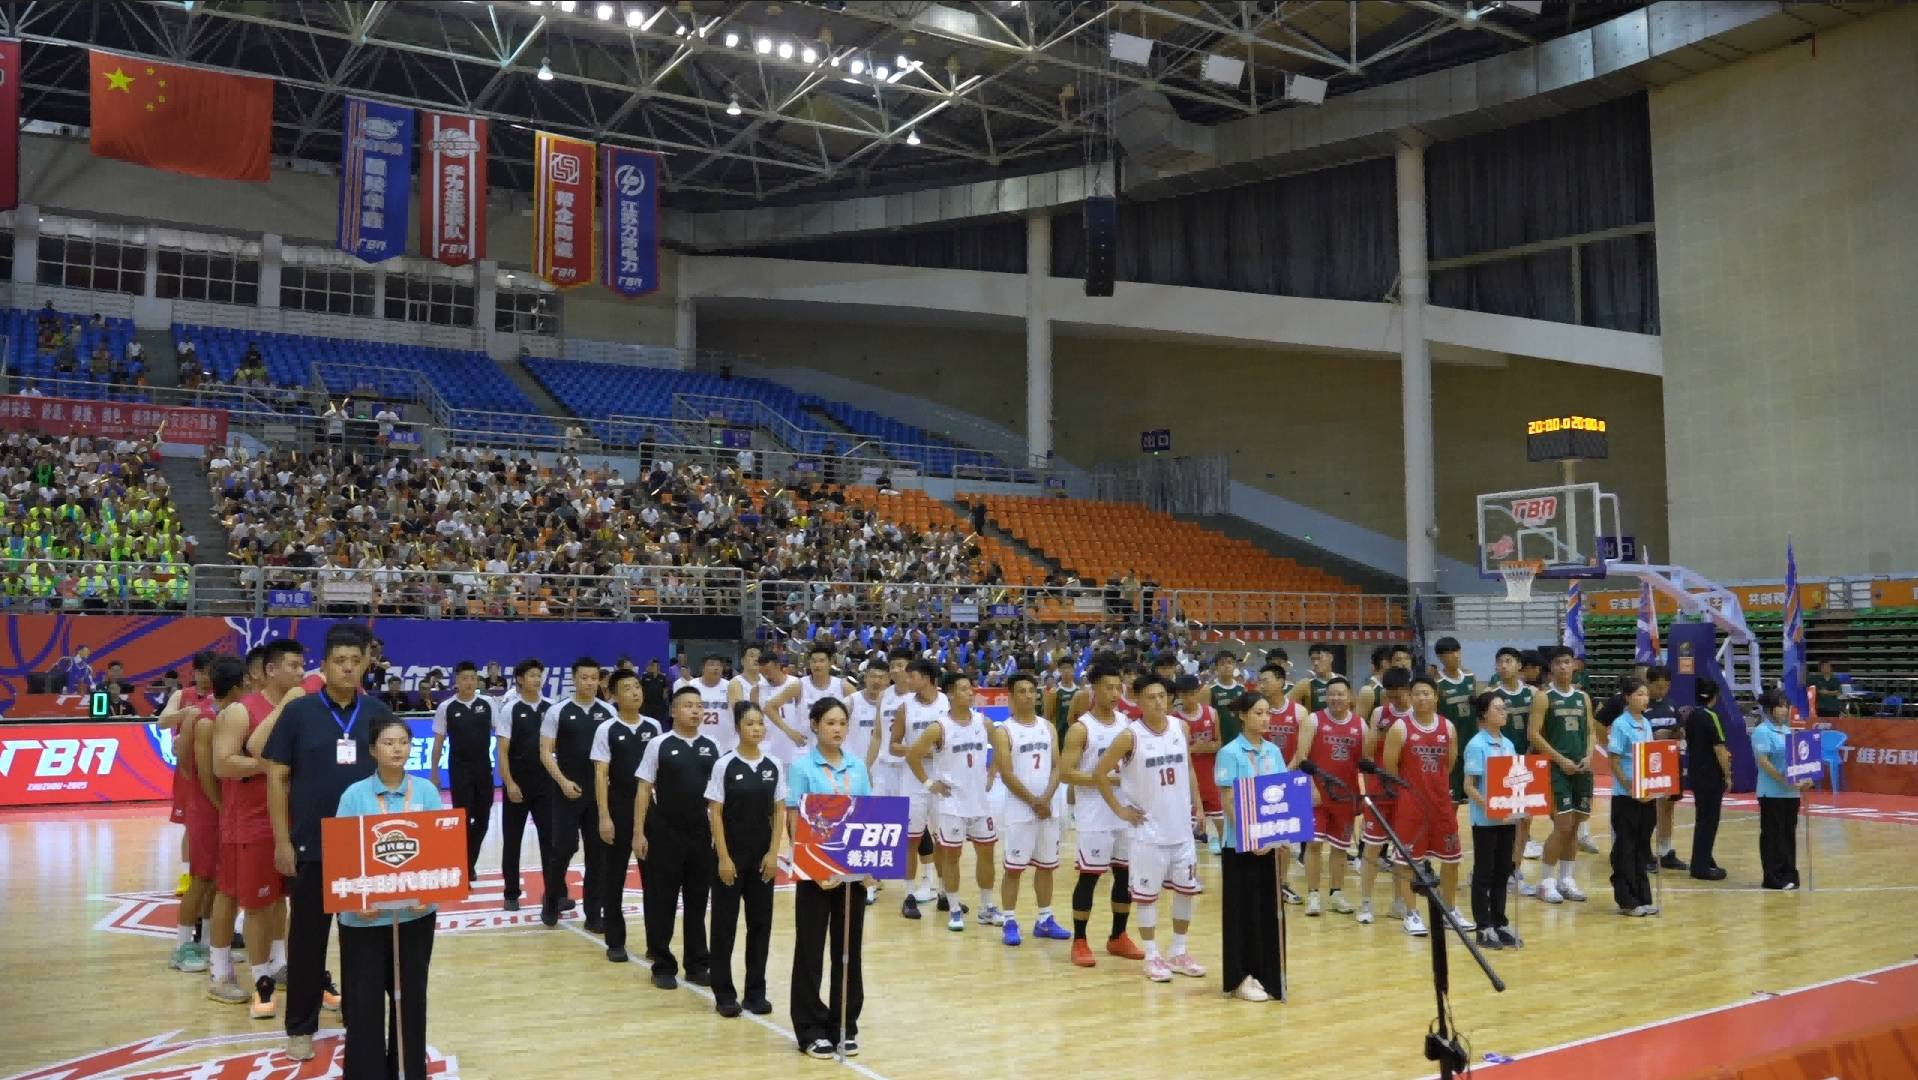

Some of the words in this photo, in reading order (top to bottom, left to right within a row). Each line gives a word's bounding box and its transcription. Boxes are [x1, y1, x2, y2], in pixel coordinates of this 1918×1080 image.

[92, 693, 108, 716] 0
[703, 711, 719, 725] 23
[1032, 753, 1041, 769] 7
[1159, 767, 1176, 786] 18
[847, 850, 894, 867] 裁判员
